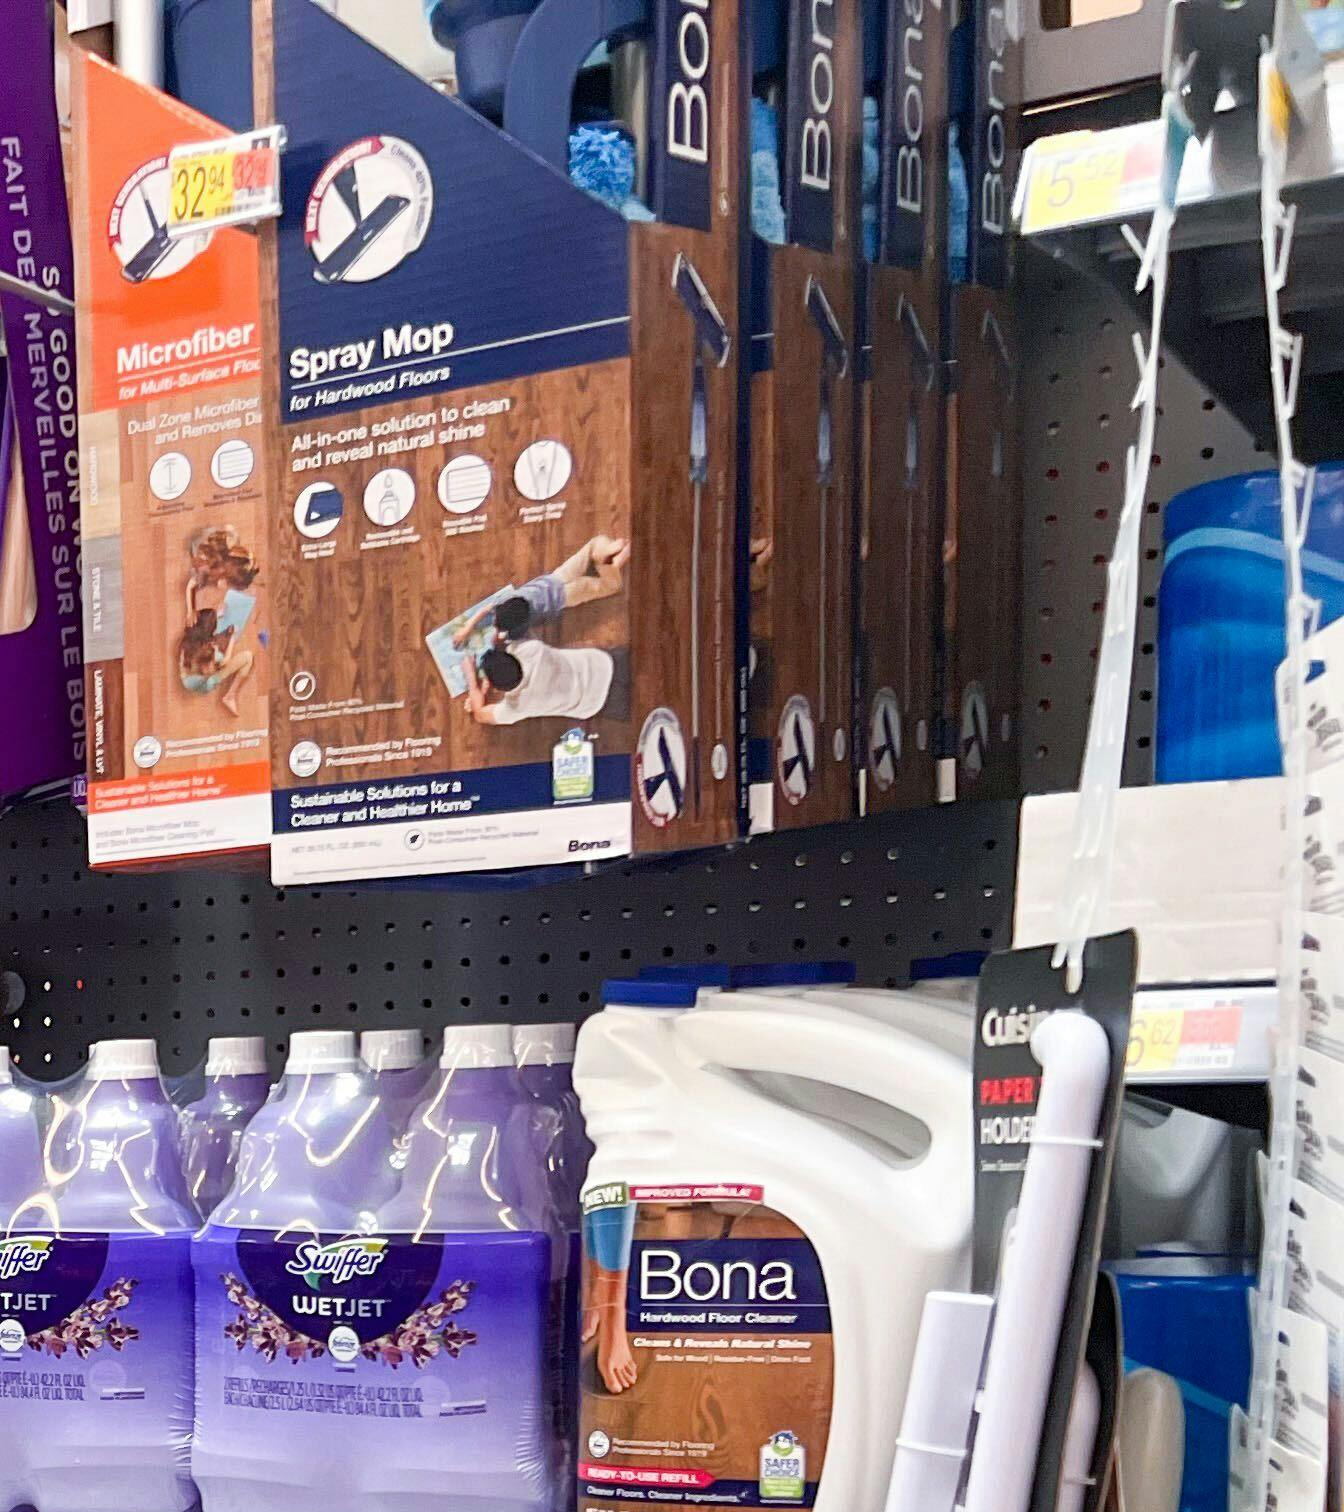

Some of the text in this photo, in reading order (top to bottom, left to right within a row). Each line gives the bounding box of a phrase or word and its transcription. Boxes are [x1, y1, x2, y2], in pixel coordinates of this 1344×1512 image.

[2, 136, 30, 216] FAIT
[117, 323, 255, 374] Microfiber
[289, 322, 454, 383] Spray Mop
[49, 335, 77, 438] GOOD
[119, 368, 232, 400] for Multi-Surface
[289, 365, 450, 413] for Hardwood Floors
[127, 396, 260, 435] Dual Zone Microfiber
[292, 398, 510, 453] All-in-one solution to clean
[292, 424, 485, 472] and reveal natural shine
[53, 545, 86, 762] SUR LE BOIS
[366, 783, 428, 801] Solutions
[430, 781, 447, 794] for
[291, 807, 340, 828] Cleaner
[342, 805, 366, 822] and
[370, 802, 428, 820] Healthier
[567, 839, 611, 855] Bona
[980, 1078, 1034, 1104] PAPER
[640, 1312, 798, 1324] Hardwood Floor Cleaner
[587, 1468, 700, 1484] READY-TO-USE REFILL
[765, 1459, 799, 1467] SAFER
